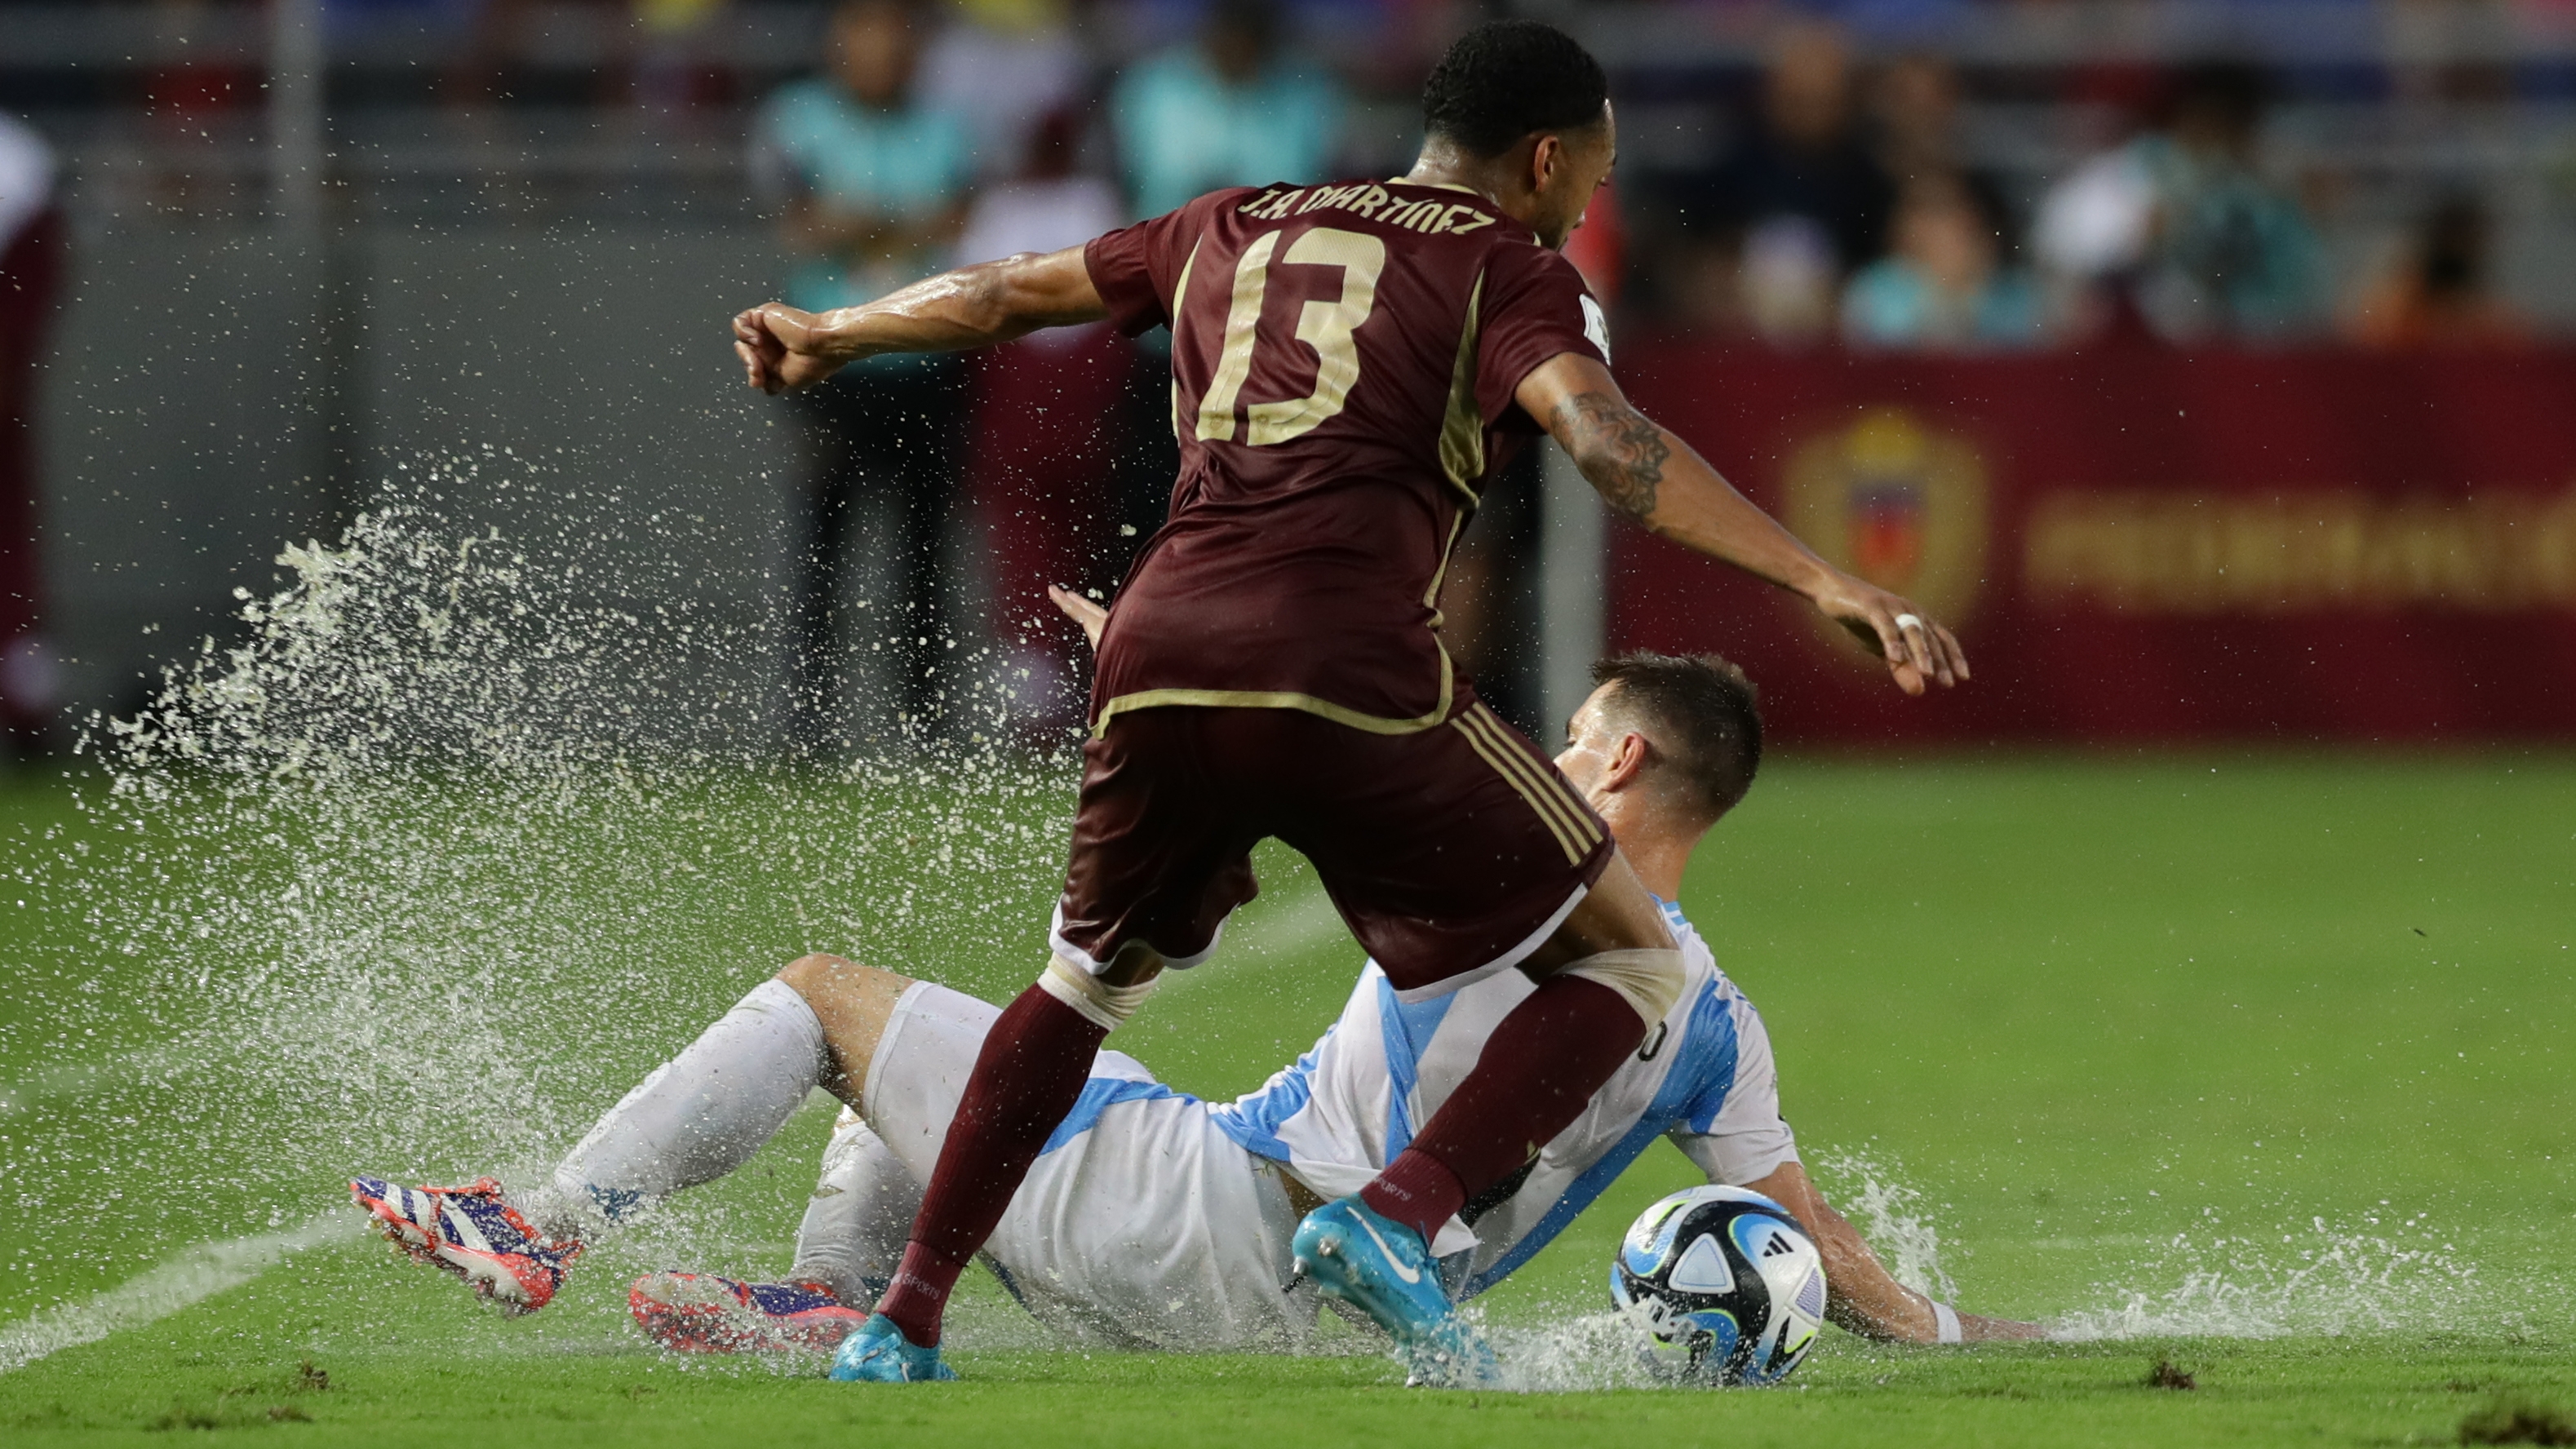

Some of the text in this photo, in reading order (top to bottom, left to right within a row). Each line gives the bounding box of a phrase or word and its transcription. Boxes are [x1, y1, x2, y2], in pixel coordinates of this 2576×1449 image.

[1237, 188, 1306, 219] J.A.
[1195, 227, 1386, 446] 13
[902, 1272, 941, 1301] SPORTS
